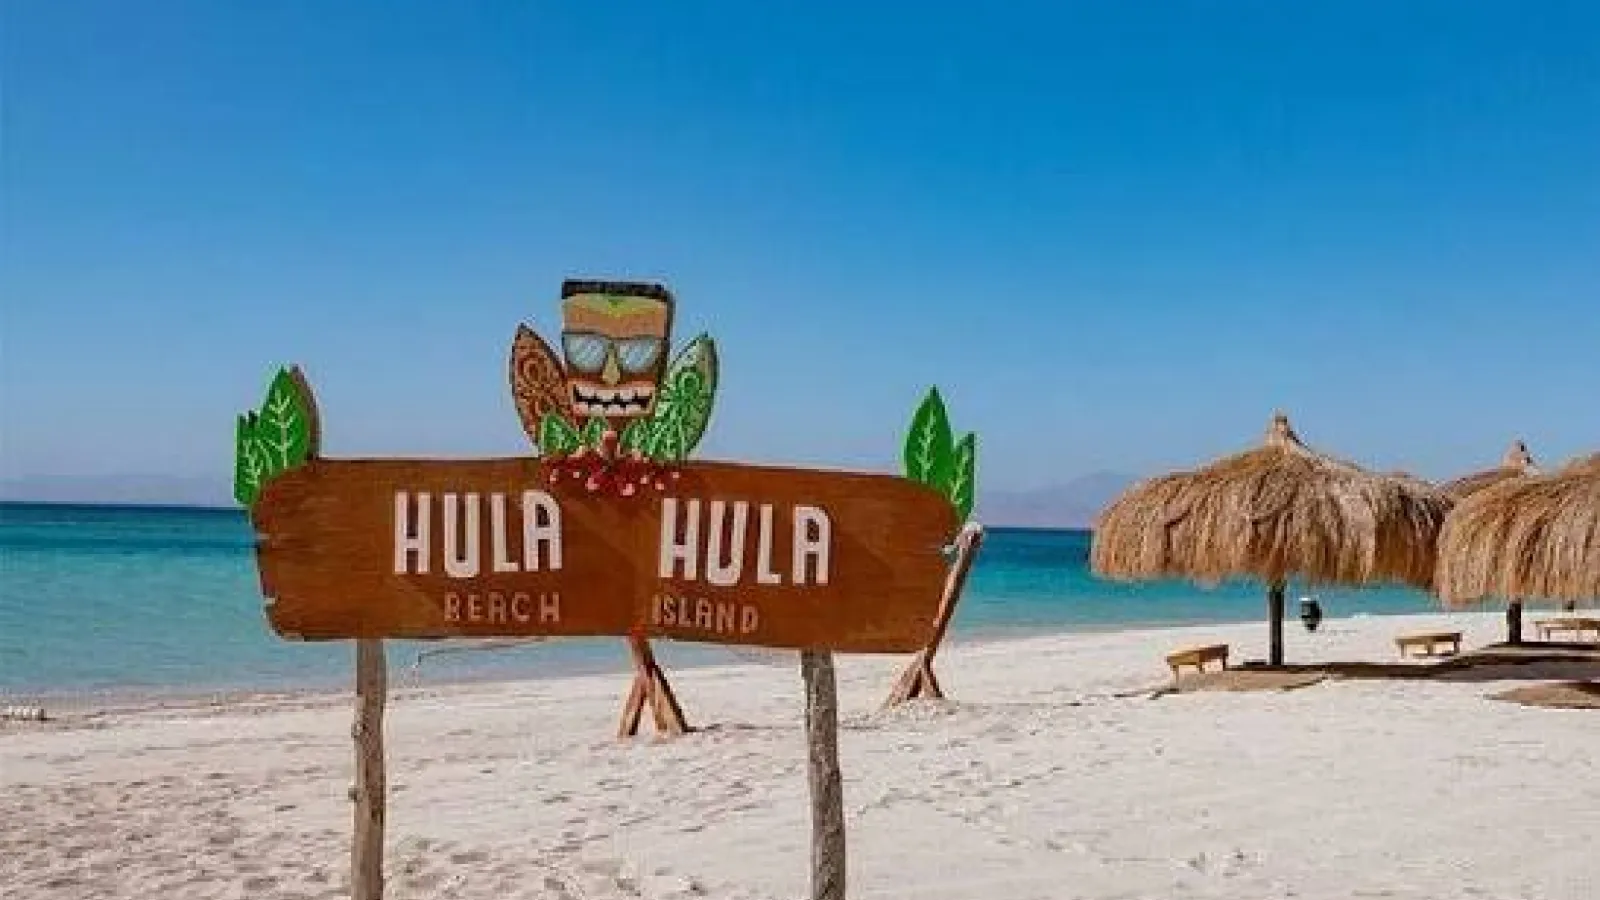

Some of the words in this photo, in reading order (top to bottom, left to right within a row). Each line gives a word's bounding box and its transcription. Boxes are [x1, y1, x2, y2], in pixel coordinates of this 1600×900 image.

[394, 490, 562, 576] HULA
[659, 497, 831, 584] HULA
[445, 592, 560, 623] BEACH
[652, 595, 759, 634] ISLAND
